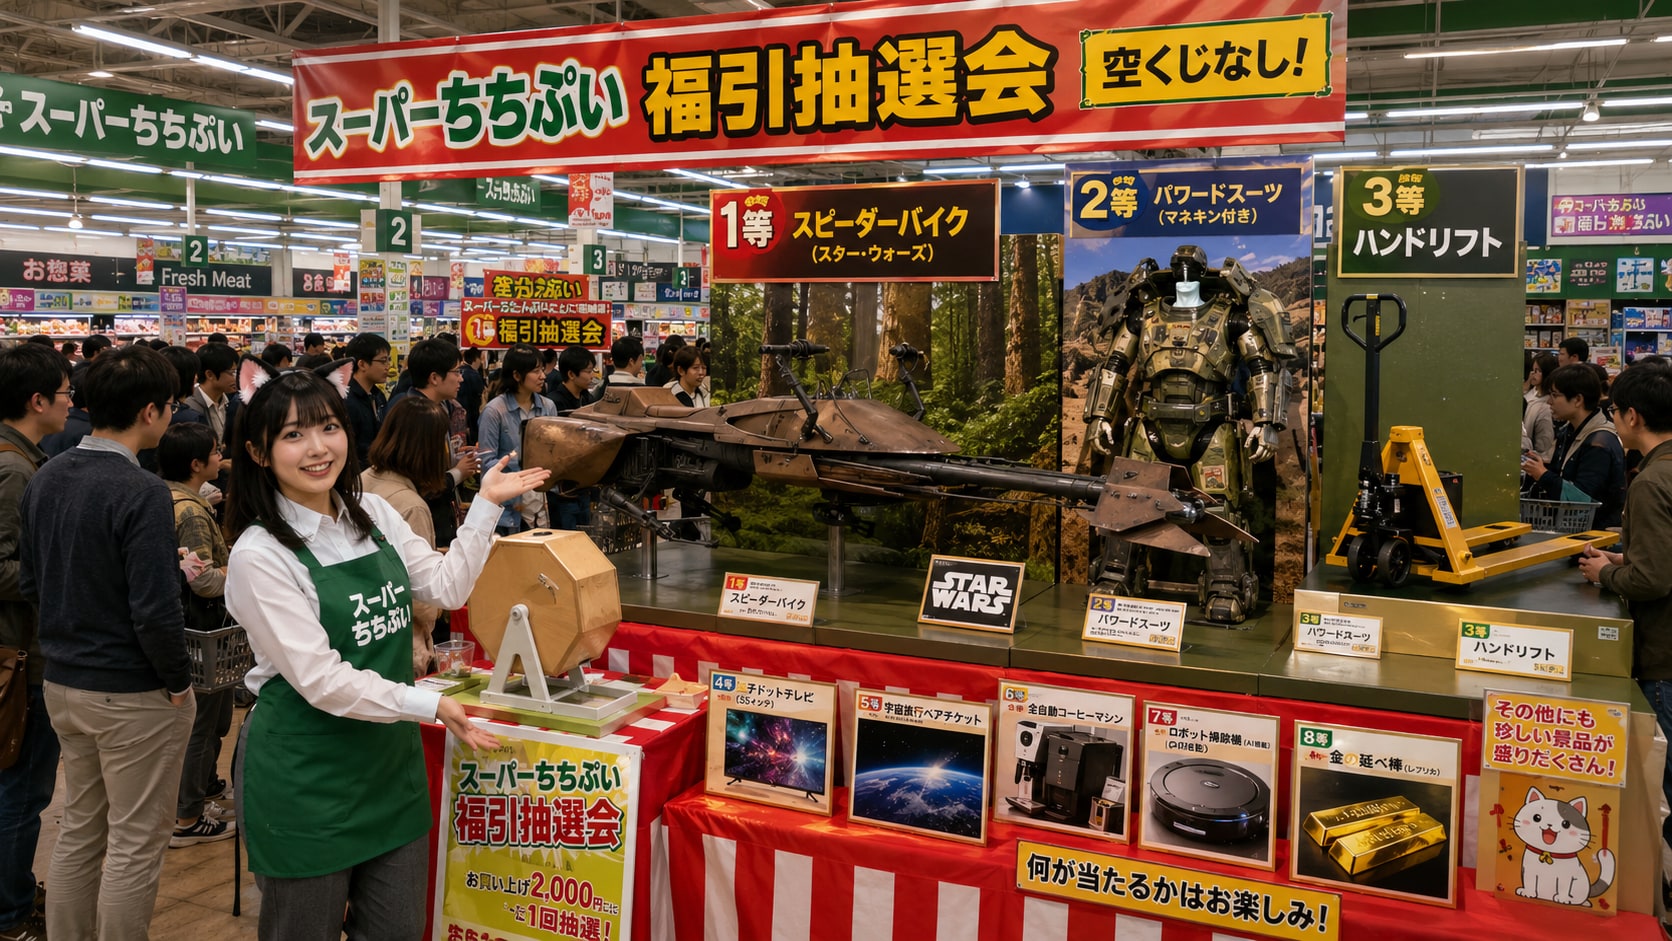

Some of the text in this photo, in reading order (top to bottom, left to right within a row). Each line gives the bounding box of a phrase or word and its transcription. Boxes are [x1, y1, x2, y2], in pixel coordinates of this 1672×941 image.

[1102, 37, 1308, 89] 空くじなし!
[643, 26, 1056, 140] 福引抽選会
[20, 90, 243, 154] スーパーちちぷい
[306, 59, 626, 160] スーパーちちぷい
[1079, 179, 1284, 219] 2等 パワードスーツ
[1361, 176, 1425, 217] 3等
[391, 216, 407, 246] 2
[720, 200, 969, 249] 1等 スピーダーバイク
[1158, 207, 1258, 226] (マネキン付き)
[189, 239, 203, 263] 2
[811, 244, 934, 265] (スター・ウォーズ)
[1352, 226, 1503, 259] ハンドリフト
[593, 249, 603, 270] 3
[161, 267, 252, 289] Fresh Meat
[498, 318, 604, 345] 福引抽選会
[349, 580, 405, 618] スーパー
[932, 571, 1013, 597] STAR
[931, 587, 1012, 615] WARS
[351, 604, 411, 647] ちちぷい
[1473, 641, 1555, 661] ハンドリフト
[1494, 700, 1596, 729] その他にも
[1494, 722, 1615, 754] 珍しい景品が
[459, 759, 622, 793] スーパーちちぷい
[1493, 743, 1617, 777] 盛りだくさん!
[455, 795, 623, 851] 福引抽選会
[1026, 852, 1328, 934] 何が当たるかはお楽しみ!
